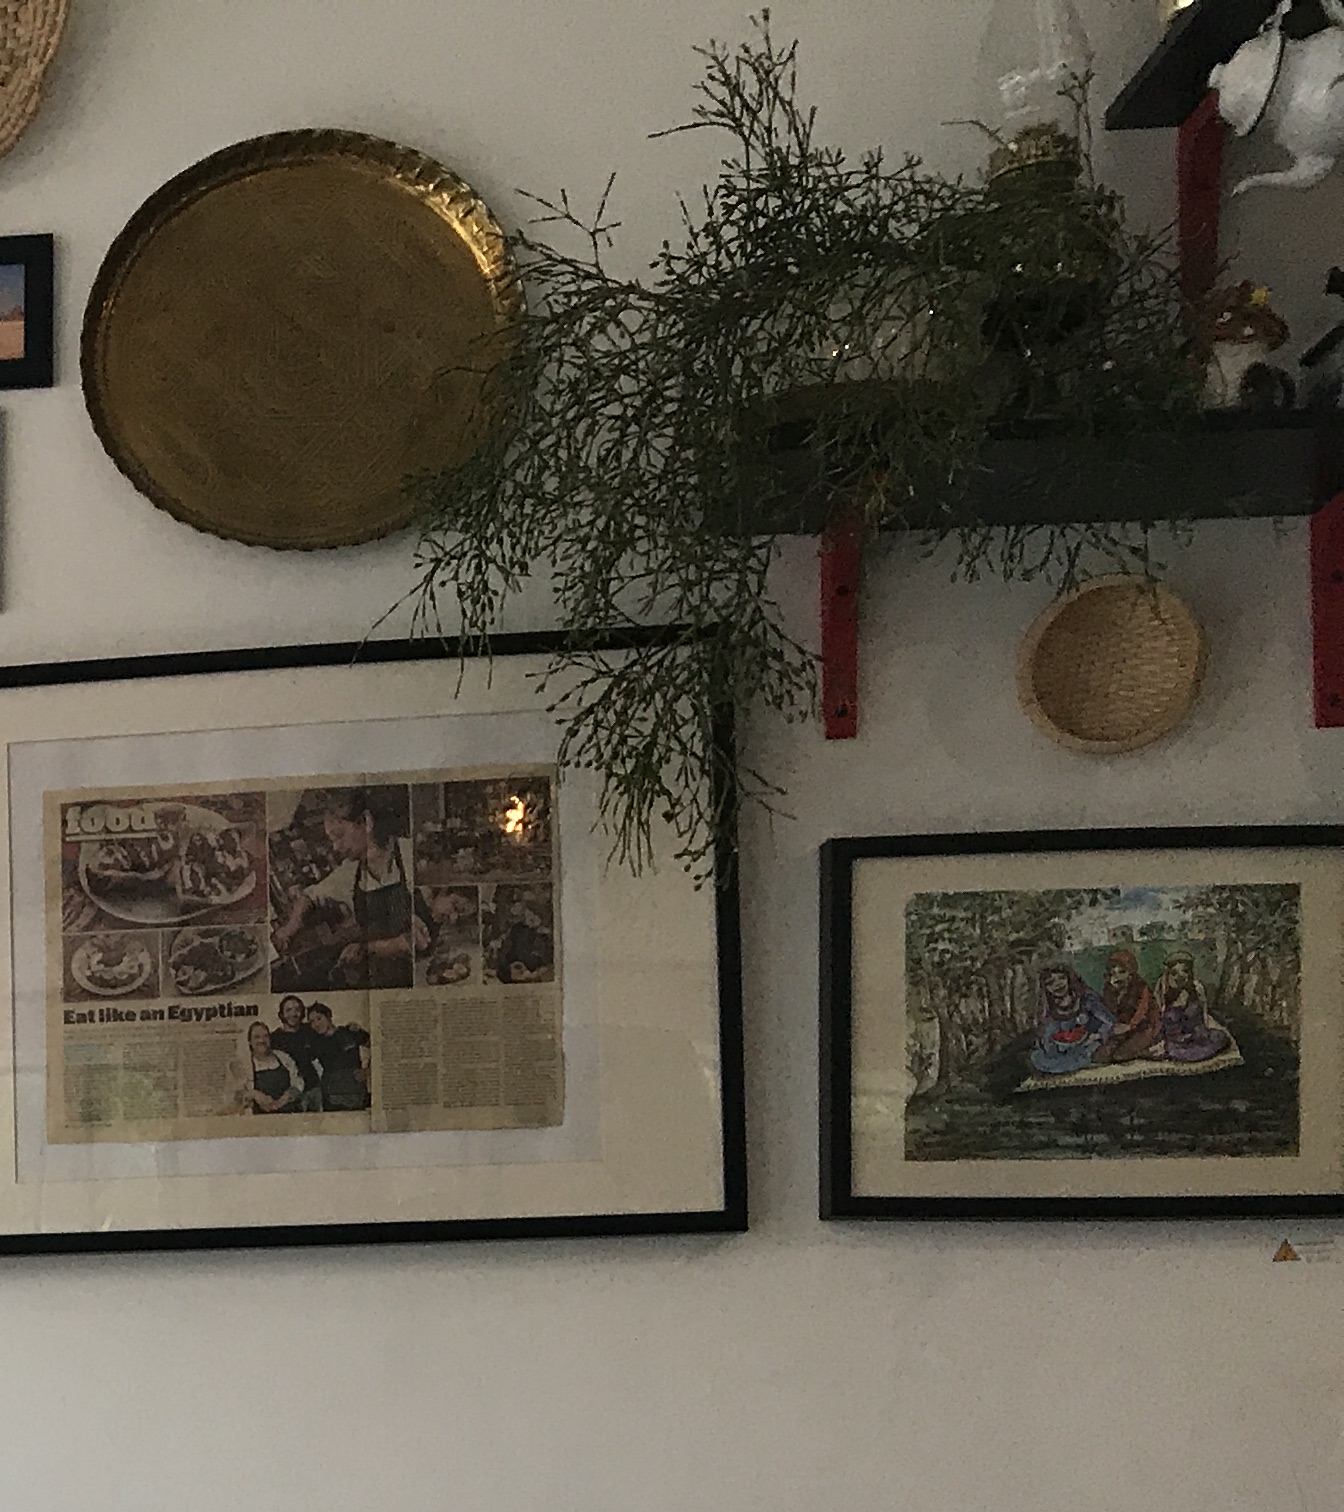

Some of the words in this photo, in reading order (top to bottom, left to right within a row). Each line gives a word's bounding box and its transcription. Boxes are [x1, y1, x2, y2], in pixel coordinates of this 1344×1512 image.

[65, 804, 157, 834] food
[63, 1009, 96, 1025] Eat
[99, 1007, 137, 1022] like
[140, 1009, 165, 1021] an
[168, 1002, 259, 1022] Egyptian
